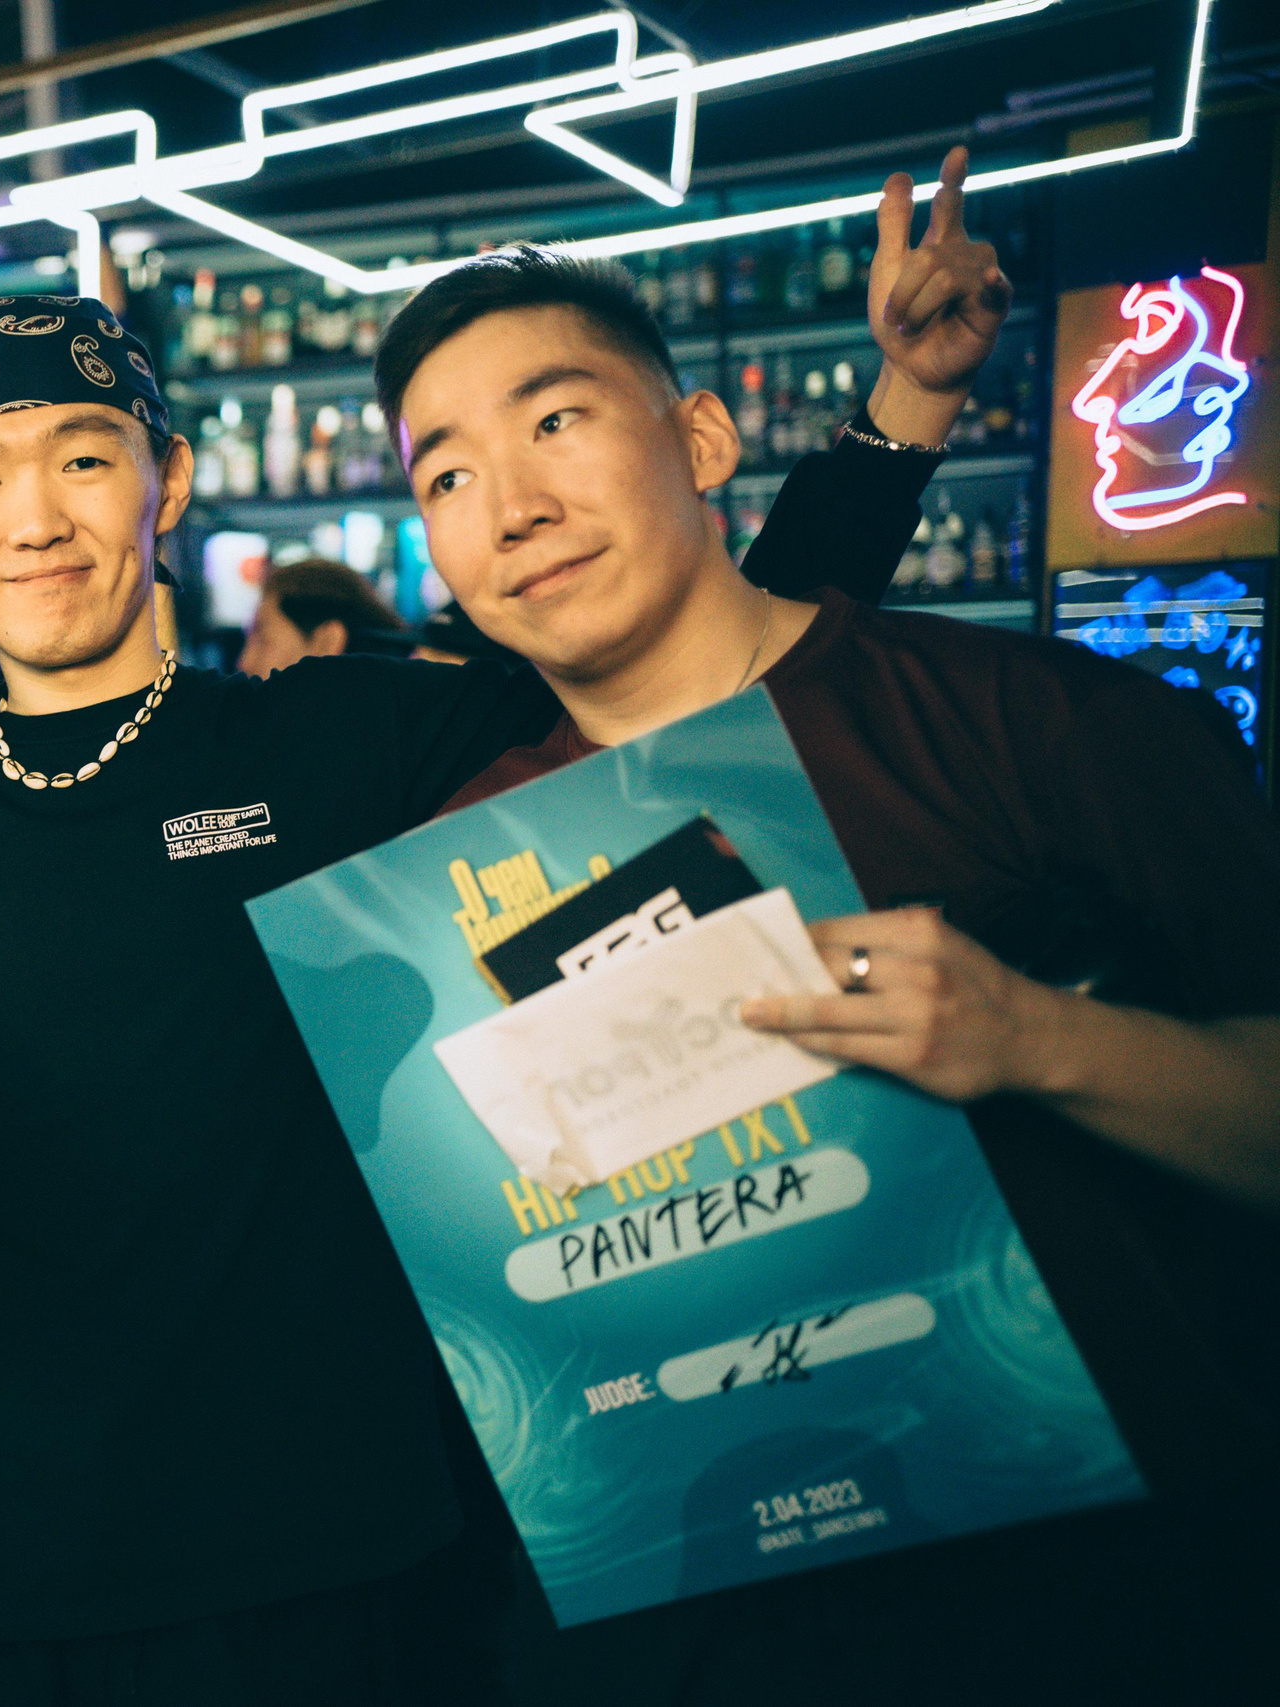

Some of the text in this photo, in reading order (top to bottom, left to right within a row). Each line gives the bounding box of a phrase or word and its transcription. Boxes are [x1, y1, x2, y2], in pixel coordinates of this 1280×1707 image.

[167, 807, 264, 836] WOLEE PLANET EARTH
[218, 819, 236, 828] TOUR
[166, 830, 249, 852] THE PLANET CREATED
[167, 834, 277, 860] THINGS IMPORTANT FOR LIFE
[559, 1164, 812, 1289] PANTERA
[583, 1371, 657, 1416] JUDGE:
